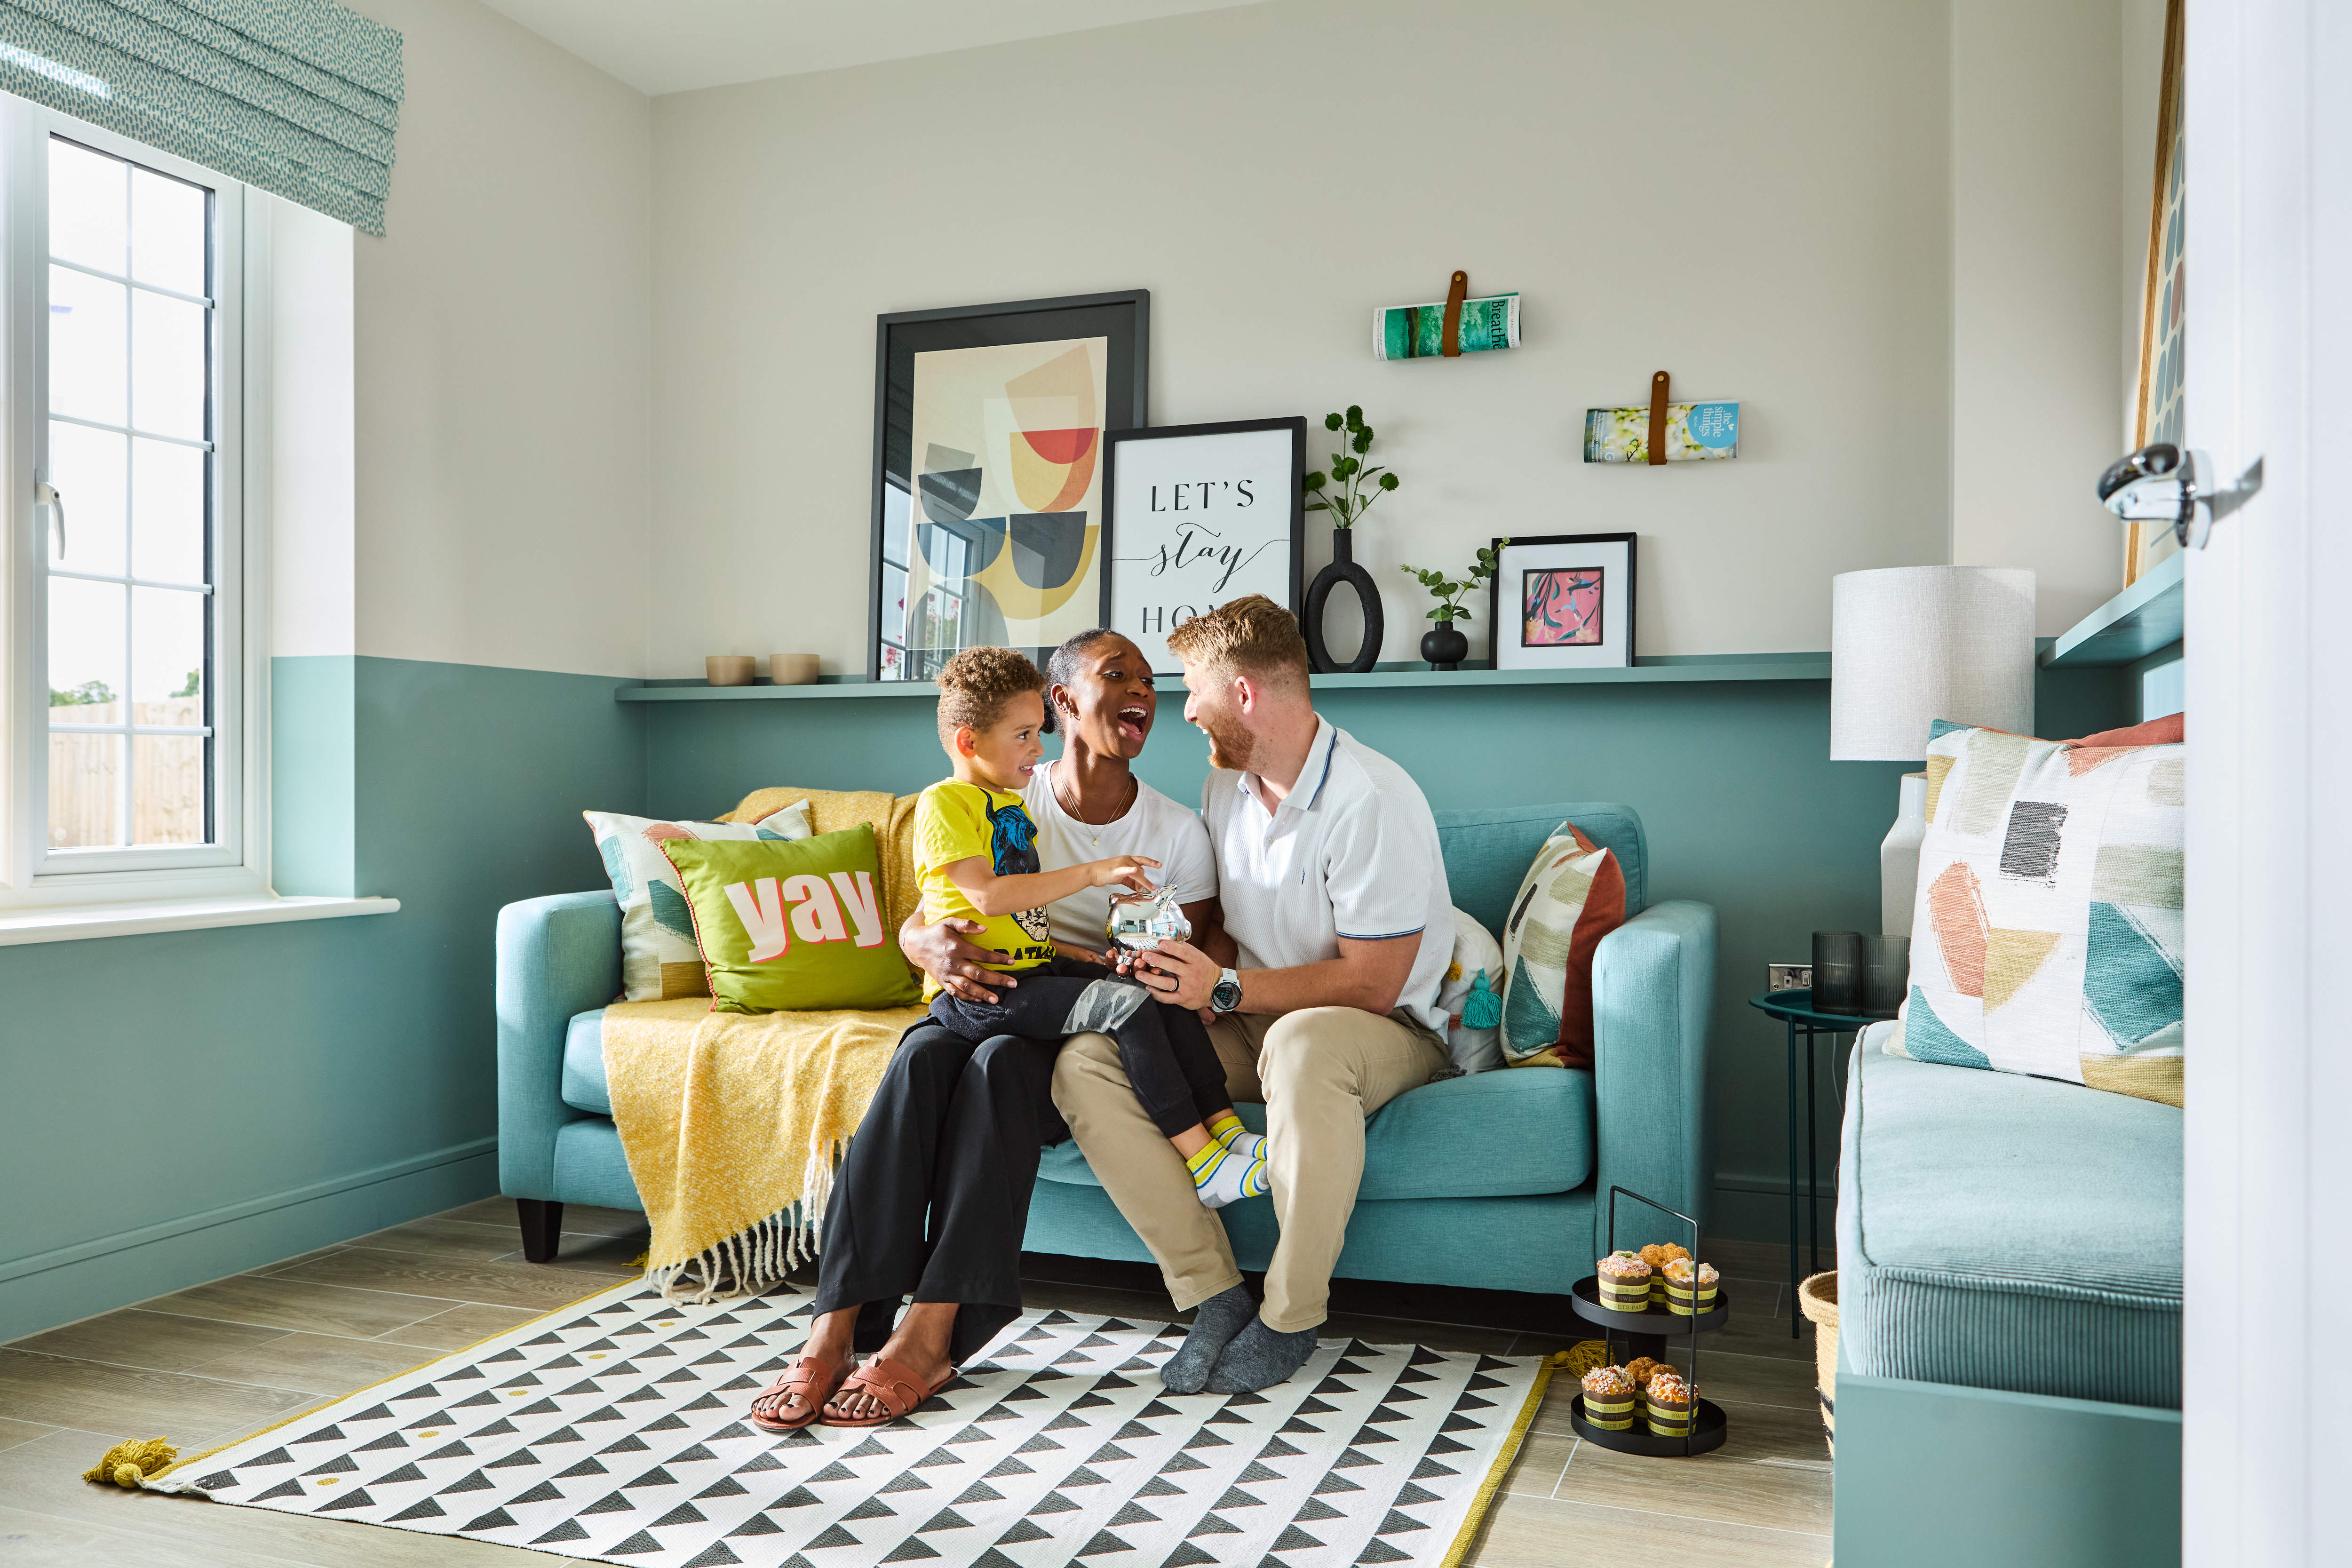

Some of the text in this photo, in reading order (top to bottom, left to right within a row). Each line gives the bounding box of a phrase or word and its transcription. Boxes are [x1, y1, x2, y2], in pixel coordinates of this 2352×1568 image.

[1491, 300, 1505, 349] Breathe
[1699, 407, 1714, 437] things
[1710, 406, 1725, 438] simple
[1723, 413, 1733, 424] the
[1152, 479, 1254, 512] LET'S
[1112, 522, 1290, 593] stay
[723, 871, 886, 964] yay
[1605, 1284, 1629, 1293] SWEETS
[1672, 1289, 1703, 1298] PARADE
[1652, 1417, 1682, 1426] PARADISE
